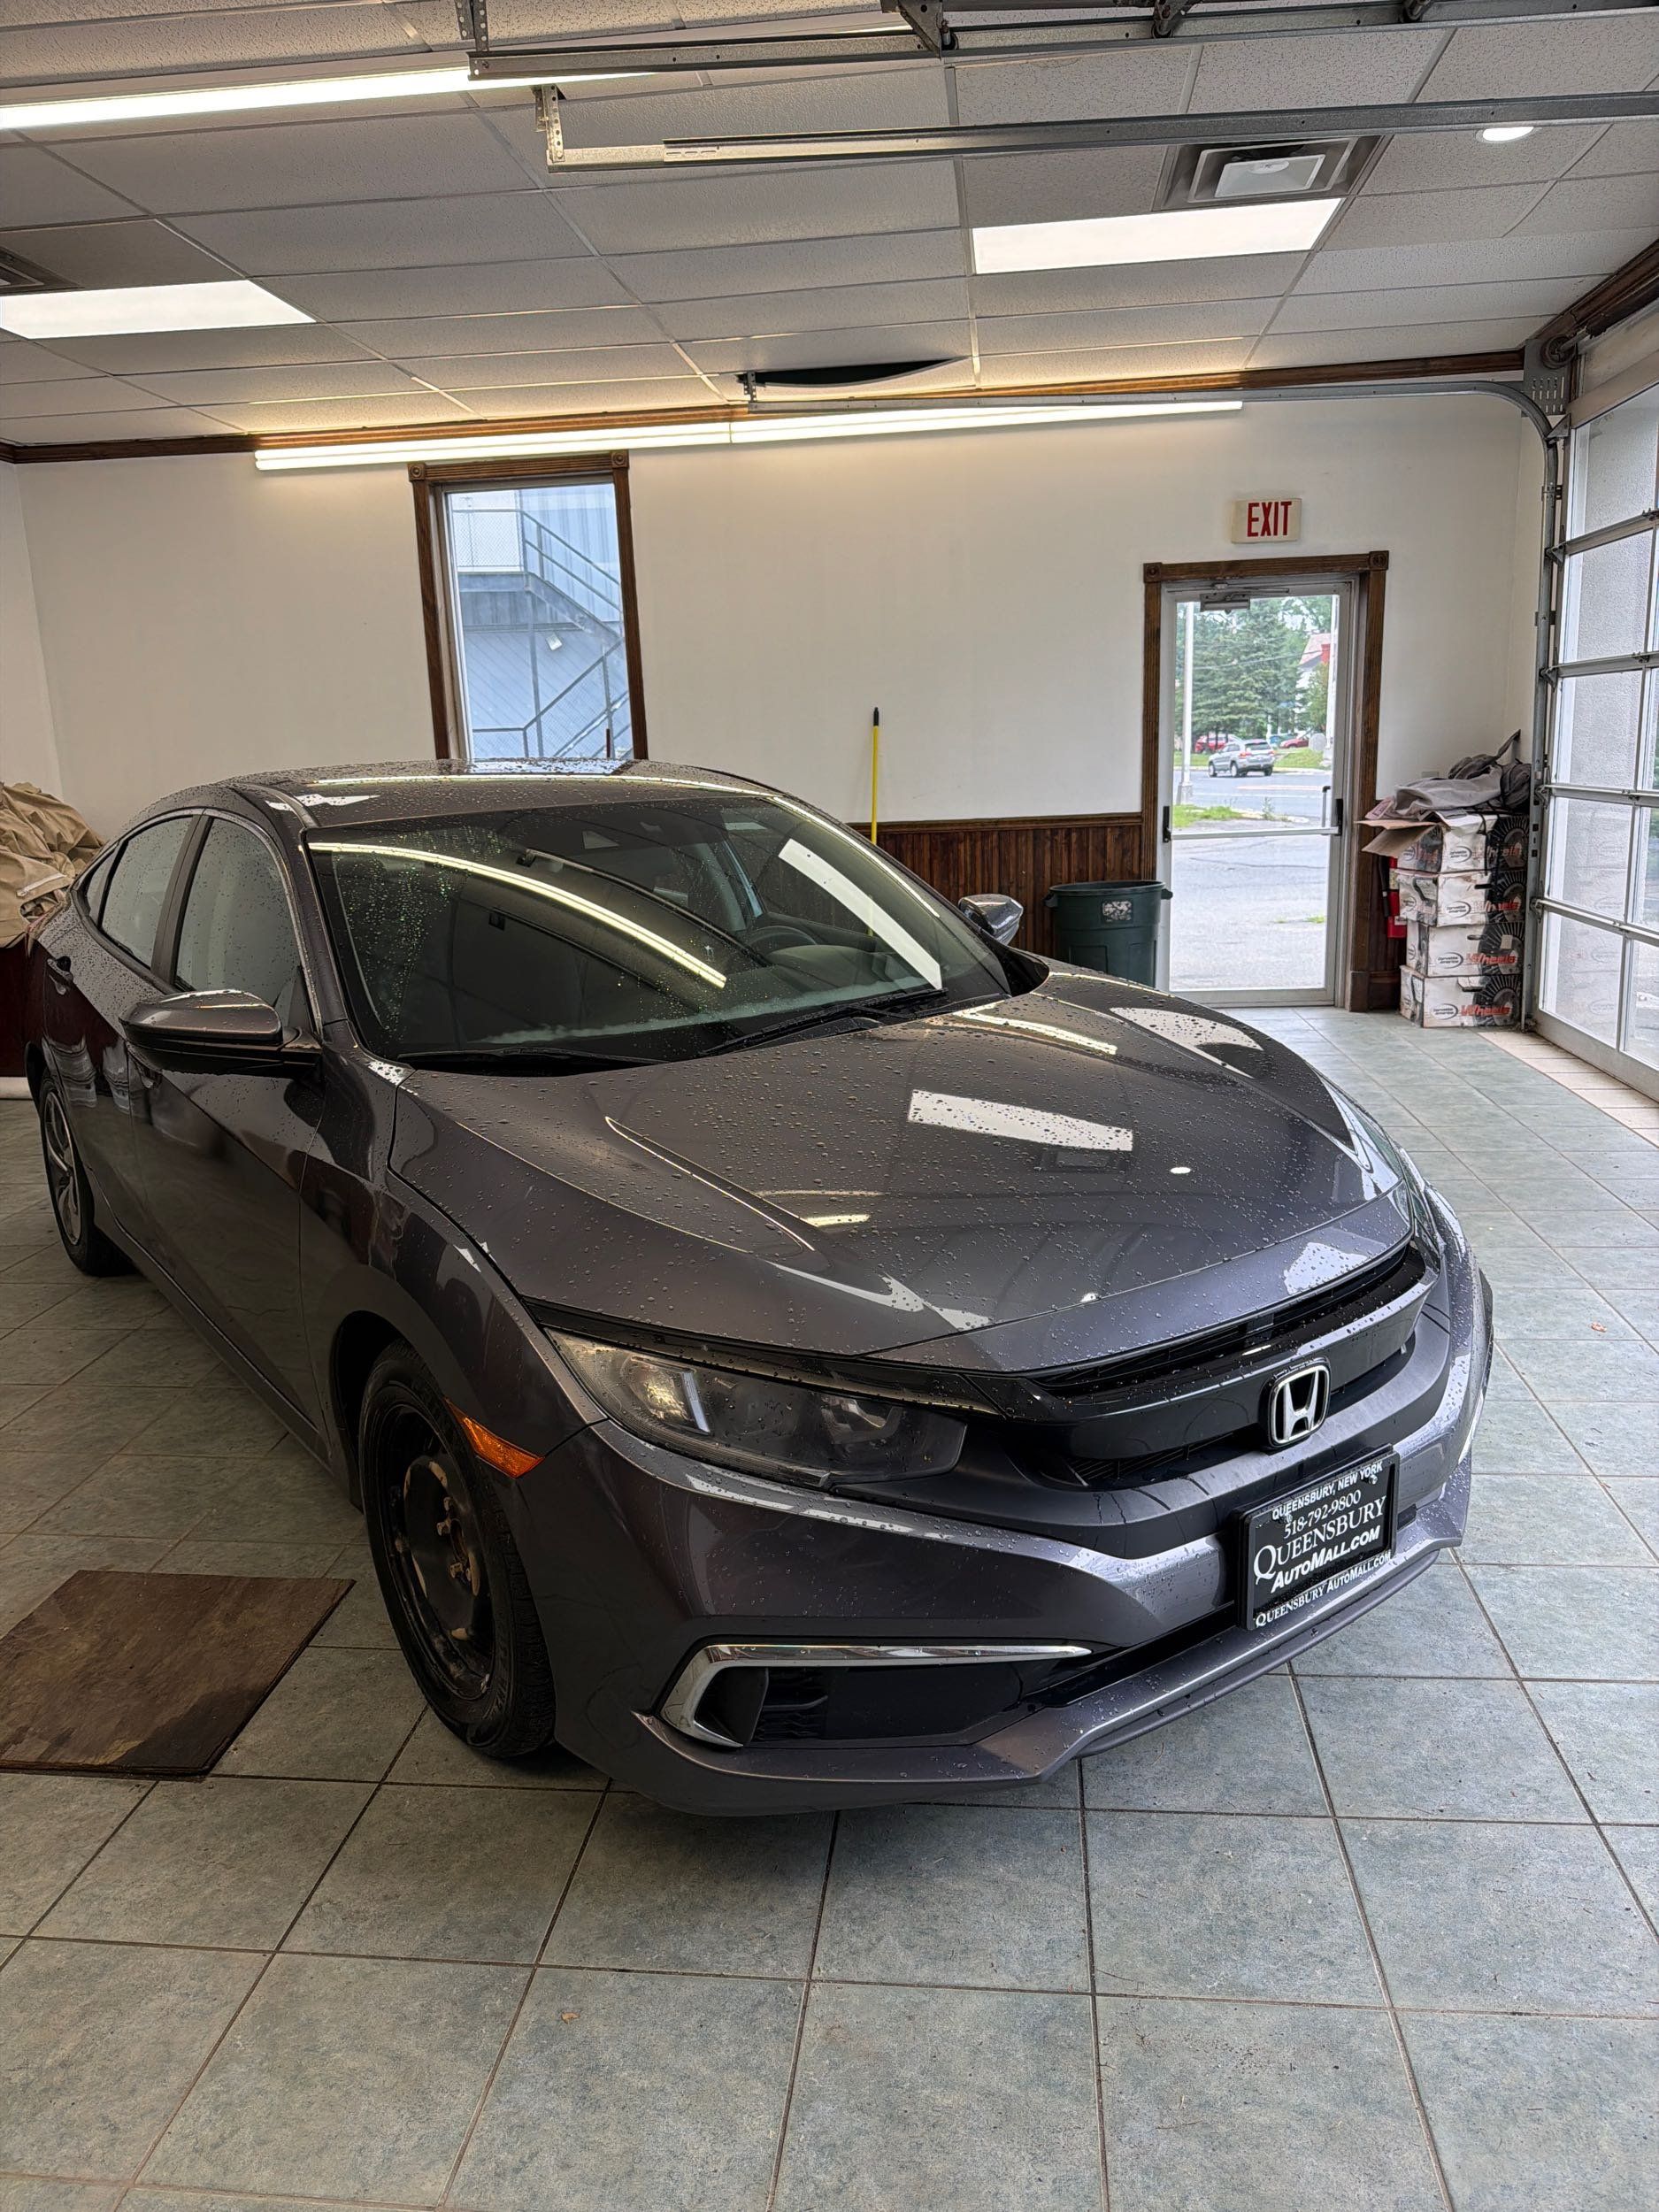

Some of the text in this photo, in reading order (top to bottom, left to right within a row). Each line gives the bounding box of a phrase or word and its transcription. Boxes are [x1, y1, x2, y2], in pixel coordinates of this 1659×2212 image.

[1247, 501, 1292, 537] EXIT
[1272, 1461, 1383, 1520] QUEENSBURY, NEW YORK
[1284, 1489, 1362, 1539] 518-792-9800
[1253, 1495, 1386, 1585] QUEENSBURY
[1255, 1585, 1326, 1628] QUEENSBURY
